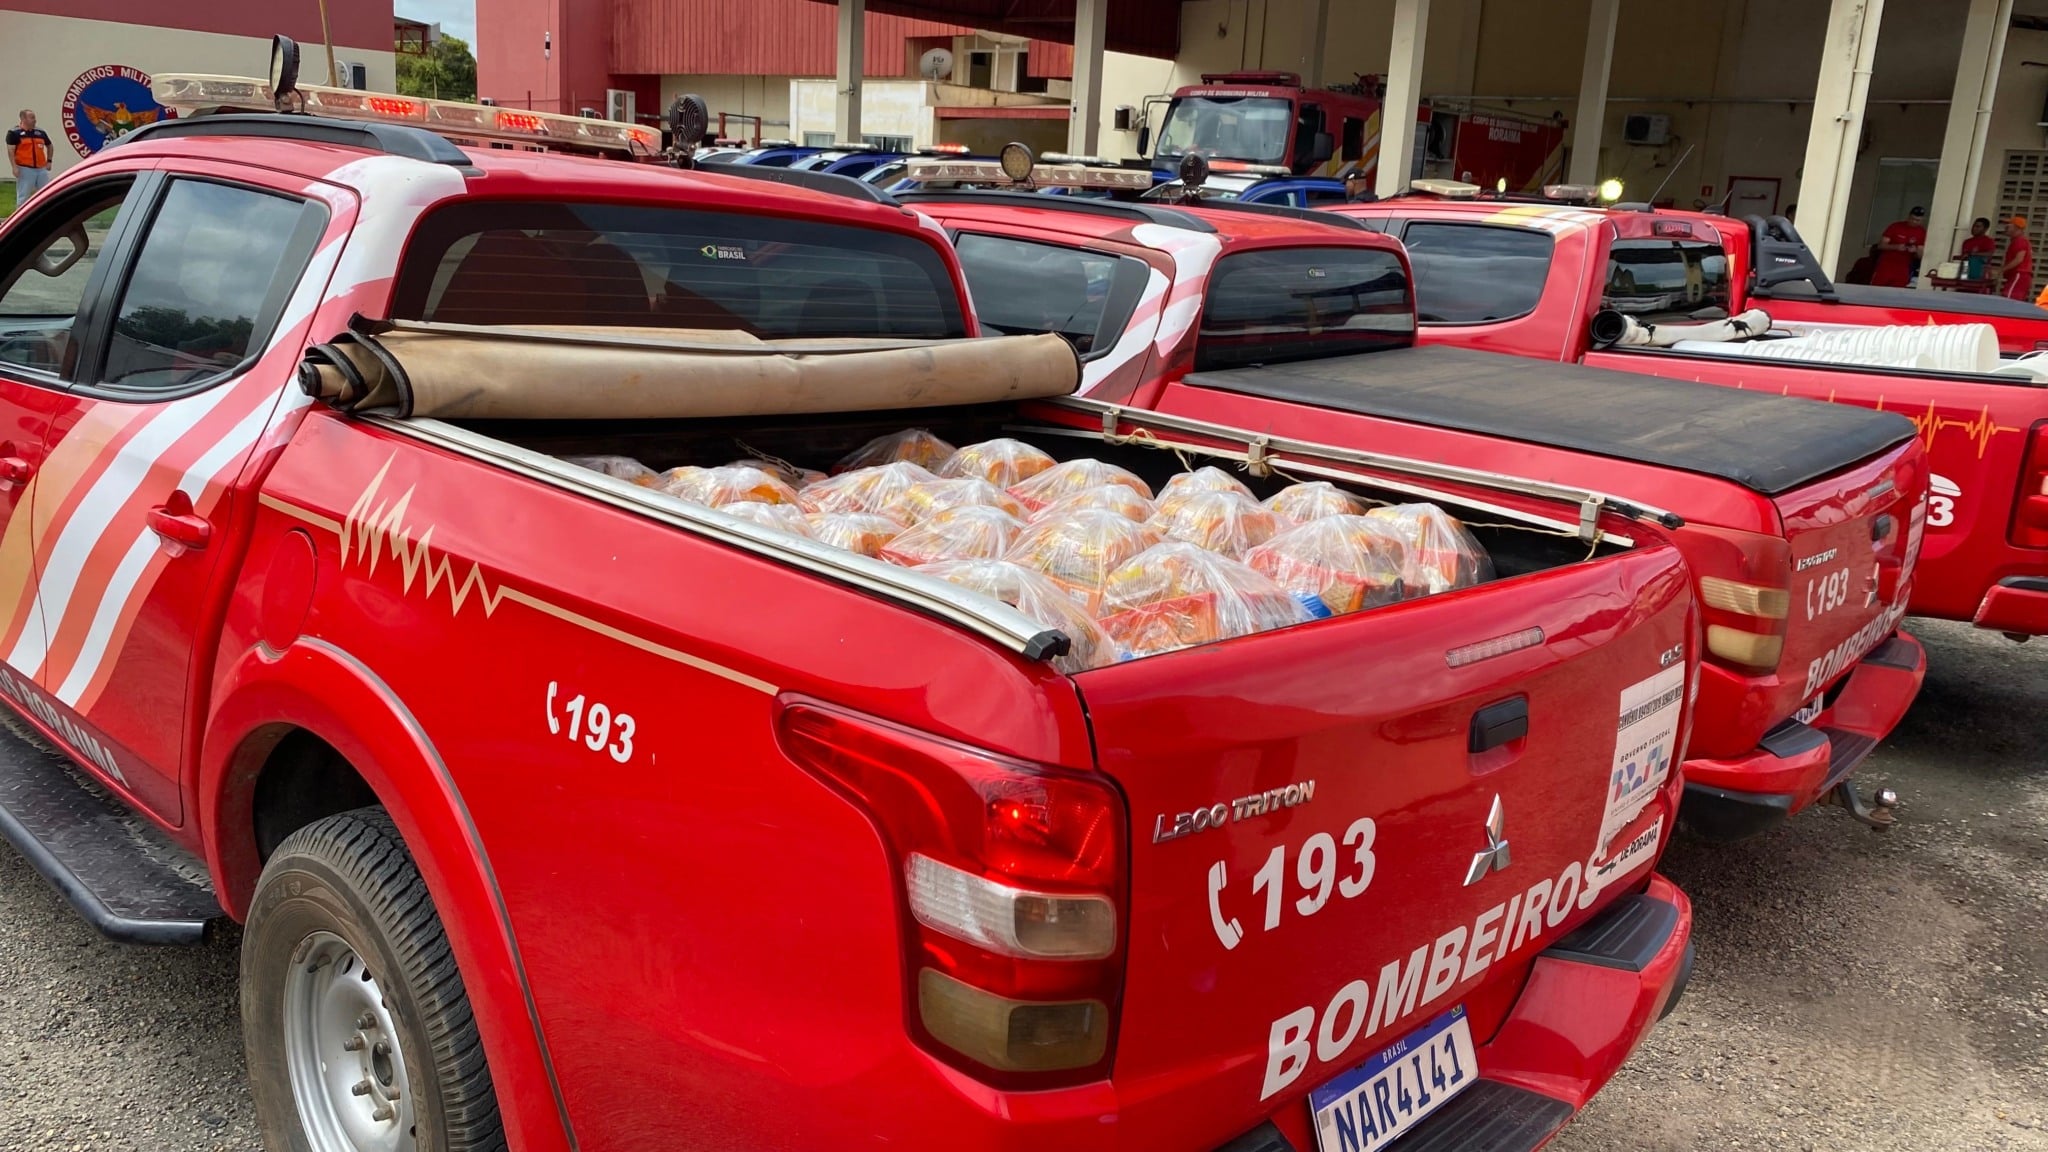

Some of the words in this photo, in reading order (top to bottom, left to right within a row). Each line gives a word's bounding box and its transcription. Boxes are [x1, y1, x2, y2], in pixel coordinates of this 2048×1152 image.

[64, 66, 114, 109] BOMBEIROS
[64, 112, 75, 128] DE
[1488, 127, 1521, 144] RORAIMA
[718, 250, 746, 260] BRASIL
[1817, 567, 1850, 616] 193
[17, 680, 131, 790] RORAIMA
[566, 694, 636, 763] 193
[1620, 742, 1648, 763] GOVERNO
[1648, 728, 1671, 747] FEDERAL
[1153, 803, 1228, 844] L200
[1232, 779, 1315, 822] TRITON
[1629, 827, 1658, 856] RORAIMA
[1253, 817, 1376, 932] 193
[1260, 845, 1607, 1102] BOMBEIROS
[1382, 1039, 1408, 1064] BRASIL
[1334, 1032, 1464, 1152] NAR4I41
